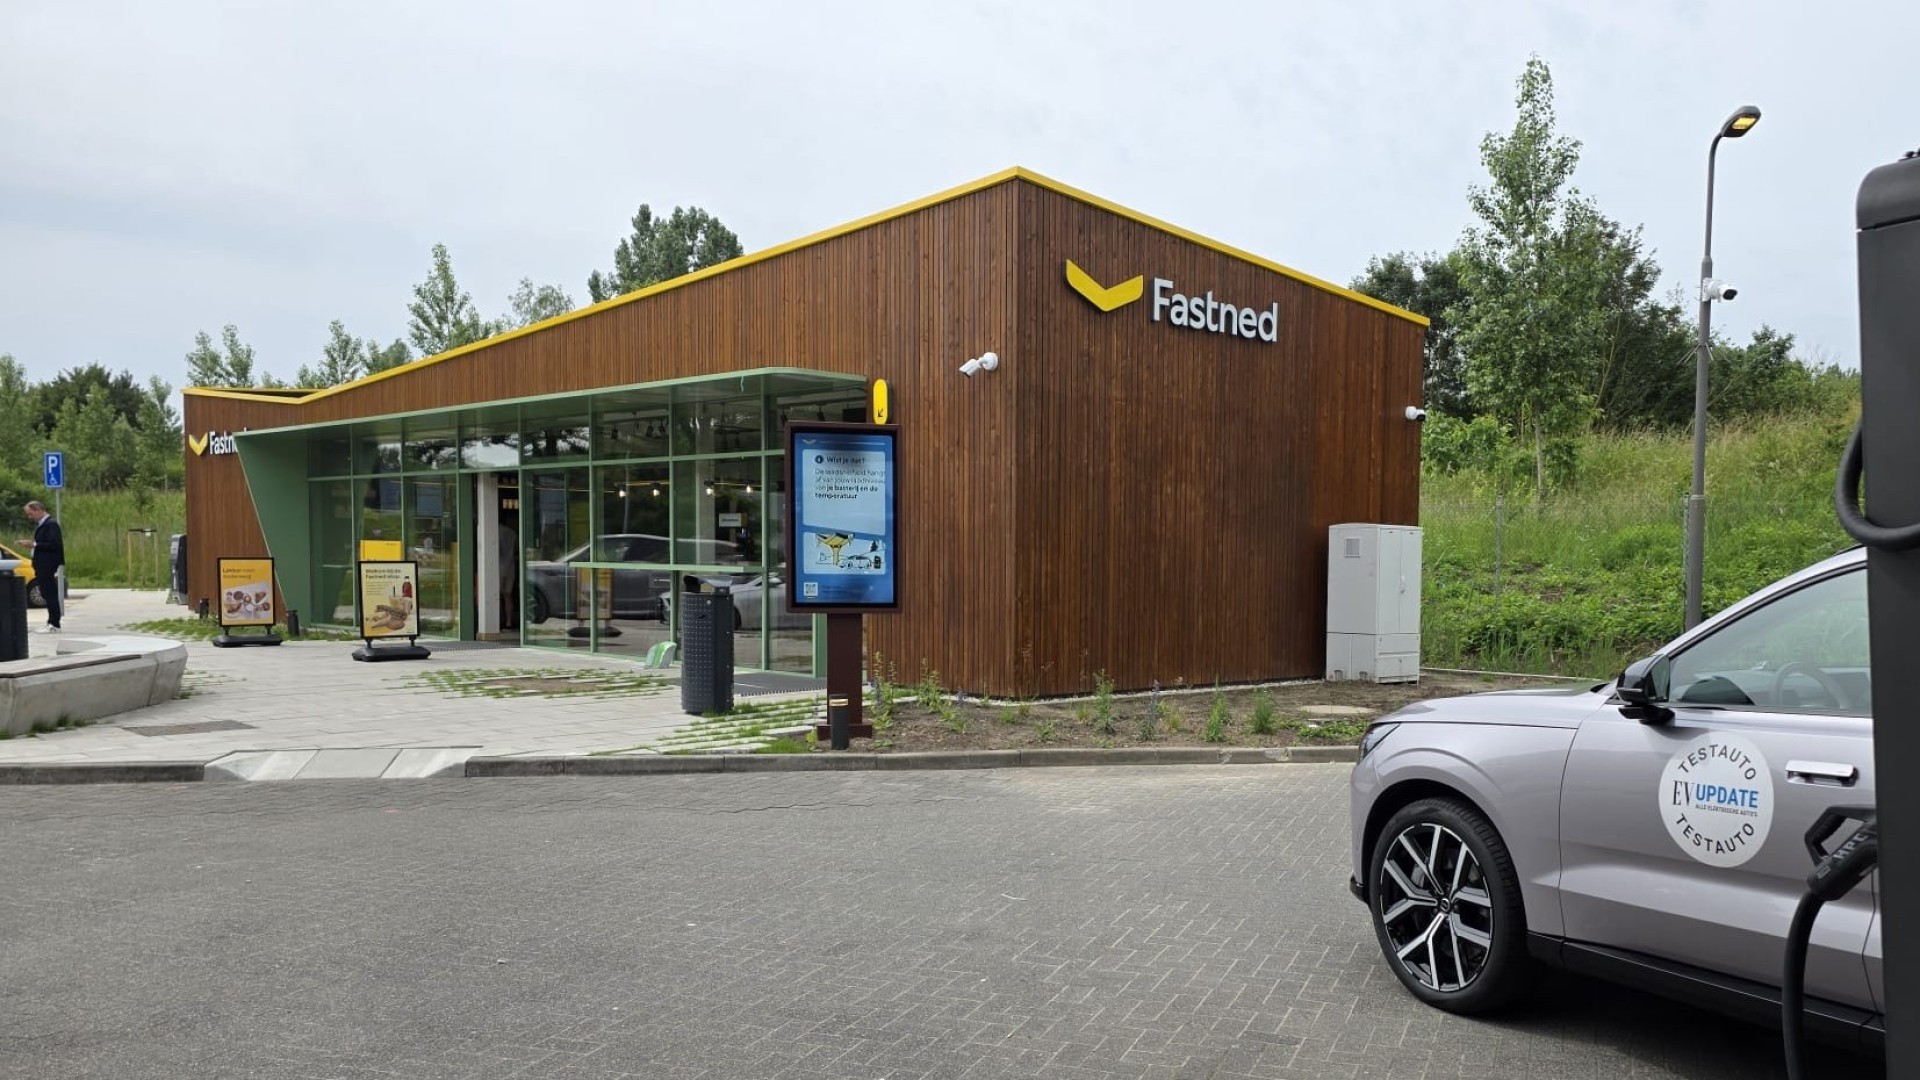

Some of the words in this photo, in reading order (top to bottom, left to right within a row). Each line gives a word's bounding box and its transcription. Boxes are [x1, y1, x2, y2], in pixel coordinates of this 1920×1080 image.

[1153, 277, 1278, 342] Fastned
[209, 427, 247, 455] Fastn
[48, 455, 58, 474] P
[1678, 744, 1757, 781] TESTAUTO
[1673, 780, 1695, 806] EV
[1696, 783, 1759, 808] UPDATE
[1676, 813, 1755, 855] TESTAUTO
